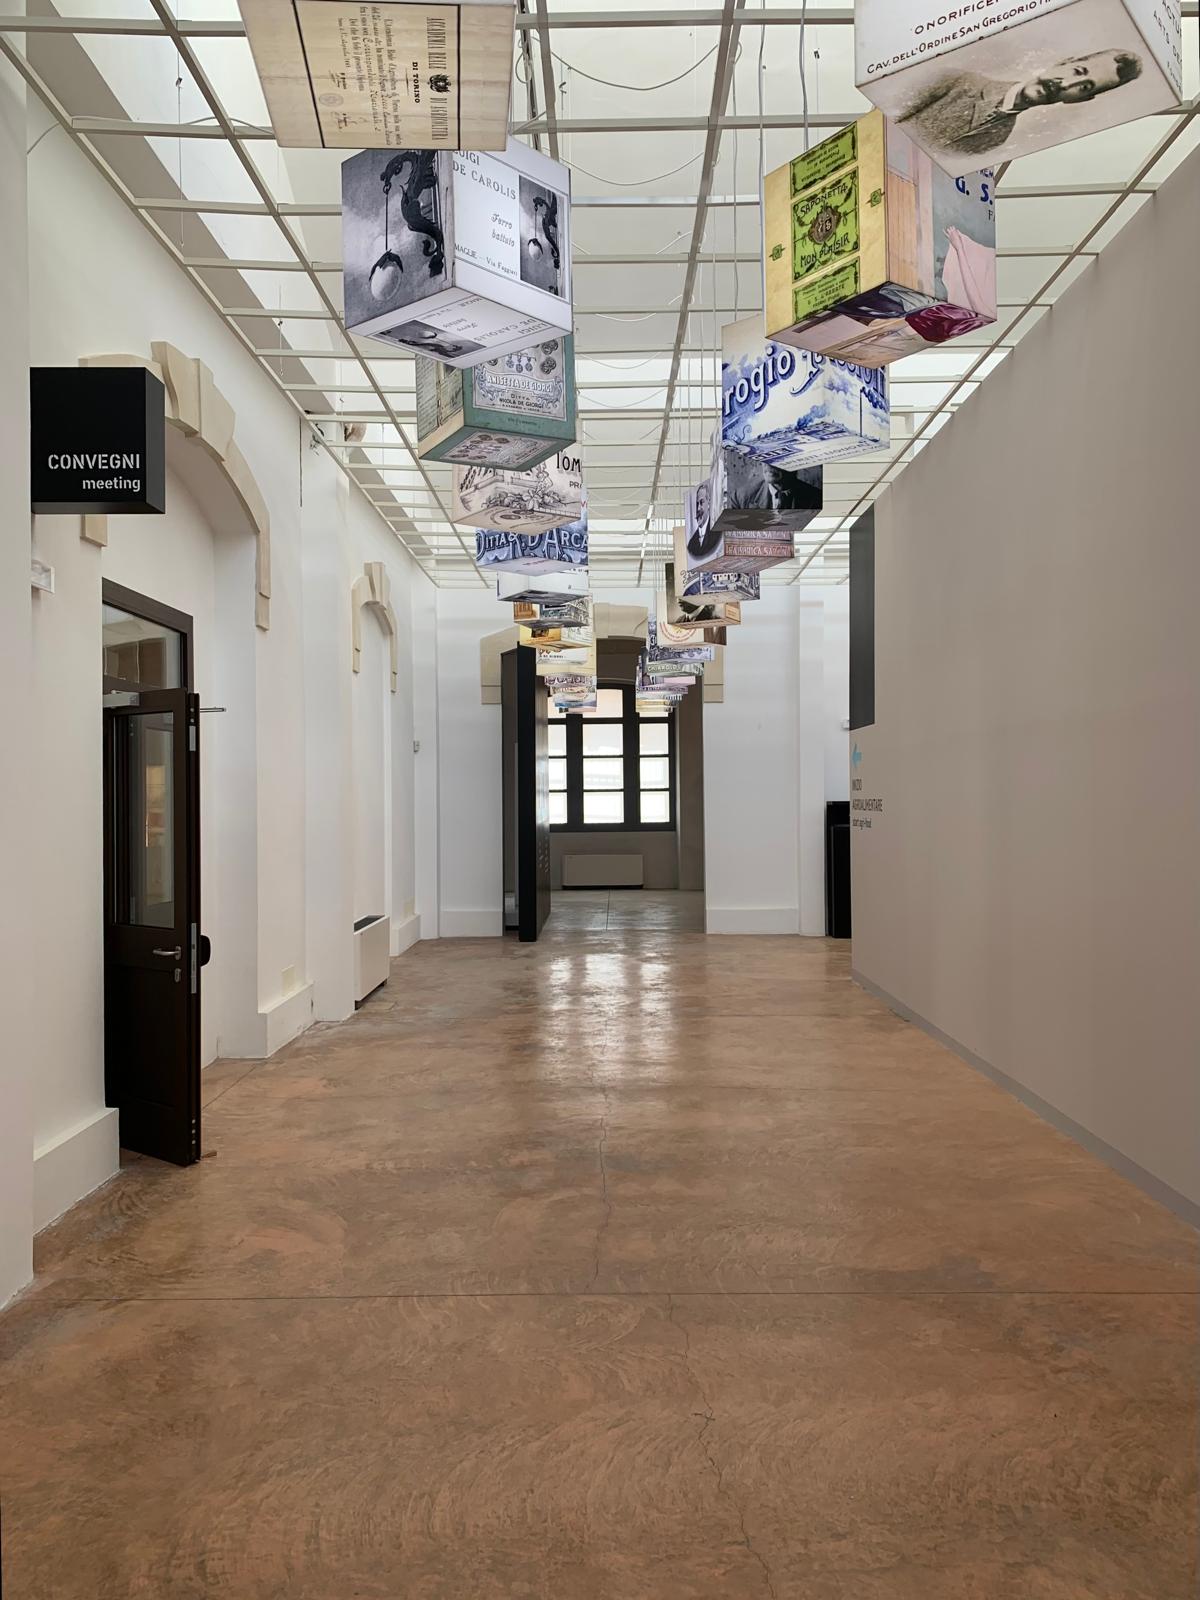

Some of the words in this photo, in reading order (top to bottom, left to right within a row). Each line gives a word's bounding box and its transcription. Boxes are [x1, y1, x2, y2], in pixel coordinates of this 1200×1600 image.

[427, 17, 446, 48] ACCADEMIA
[914, 0, 1001, 35] ONORIFICE
[867, 59, 892, 74] CAV.
[959, 22, 981, 38] SAN
[982, 1, 1037, 28] GREGORIO
[412, 62, 418, 70] DI
[428, 52, 447, 69] REALE
[412, 73, 420, 103] TORINO
[430, 105, 448, 140] AGRICOLTURA
[452, 160, 467, 176] DE
[472, 170, 516, 200] CAROLIS
[980, 183, 993, 206] S.
[800, 182, 848, 216] SAPONETTA
[800, 253, 817, 268] MON
[47, 453, 141, 470] CONVEGNI
[82, 476, 141, 493] meeting
